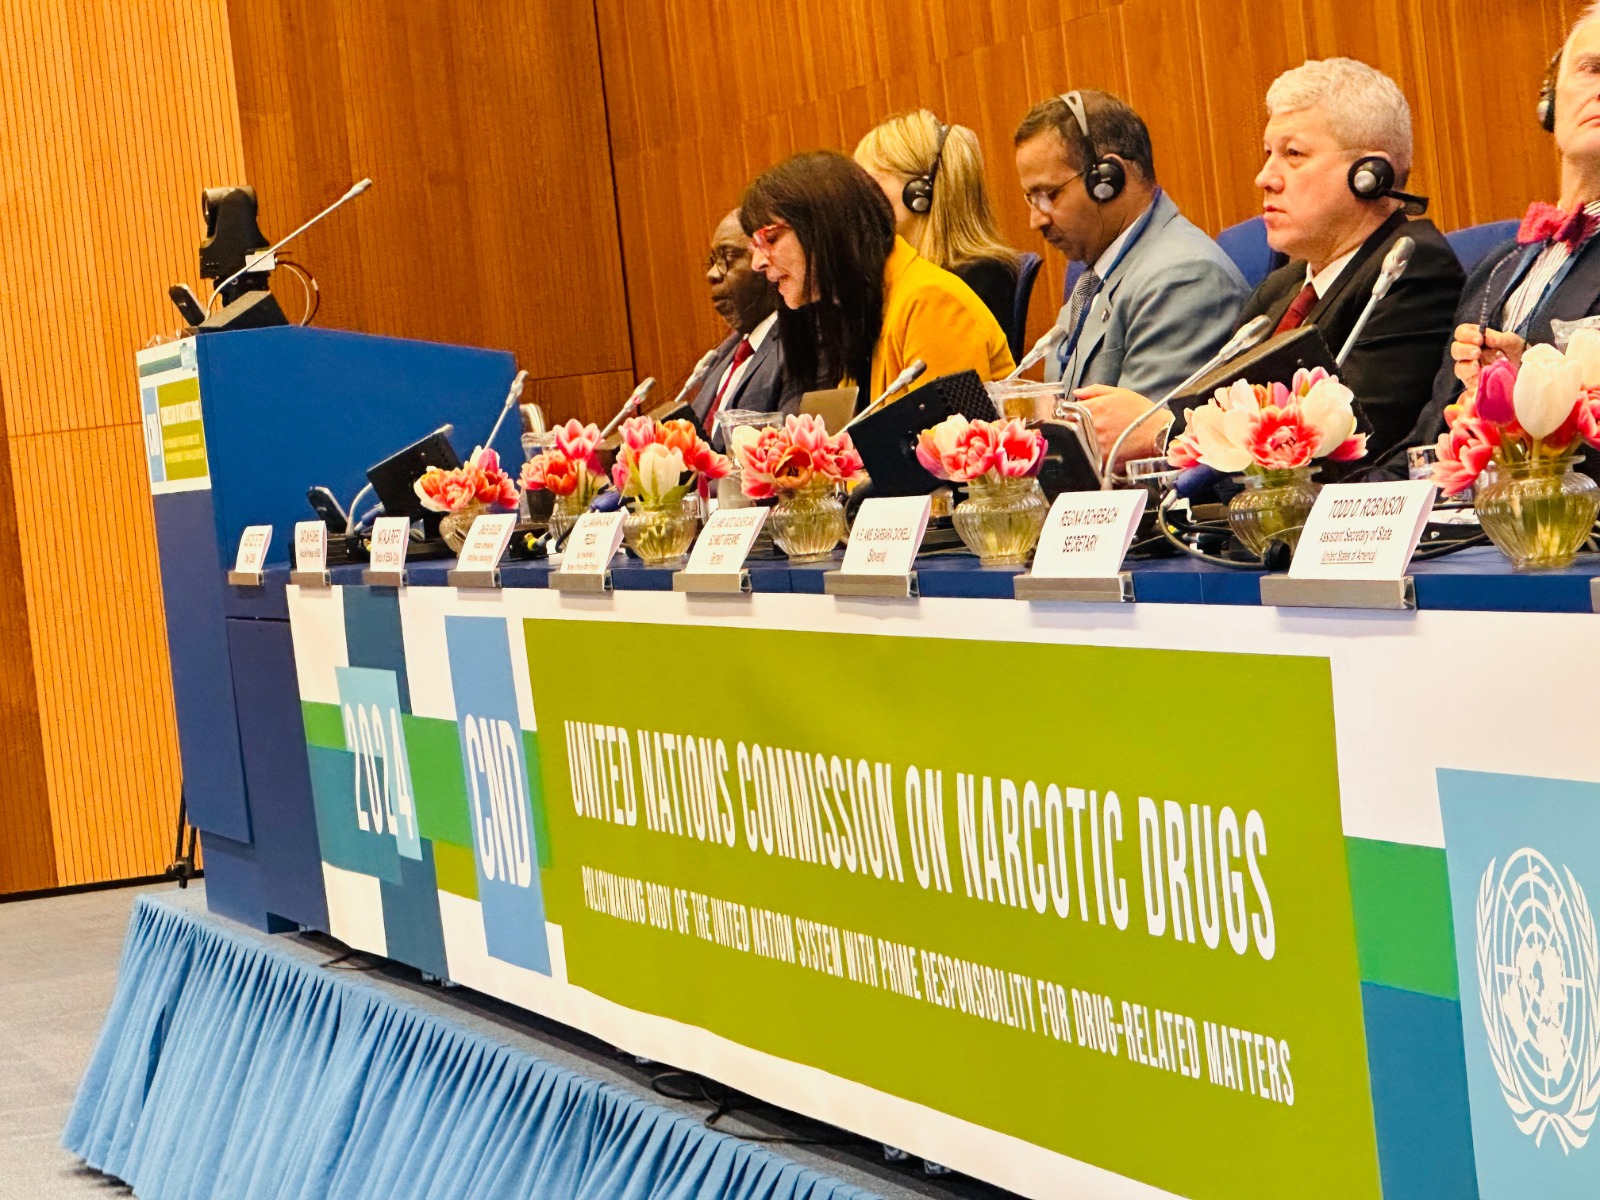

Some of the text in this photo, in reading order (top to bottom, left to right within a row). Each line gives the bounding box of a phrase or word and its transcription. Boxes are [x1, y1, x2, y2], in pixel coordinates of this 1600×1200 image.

[1060, 510, 1085, 527] REGINA
[1062, 534, 1099, 553] SECRETARY
[1328, 498, 1354, 518] TODD
[1360, 495, 1408, 517] ROBINSON
[1343, 527, 1370, 545] Secretary
[1376, 525, 1393, 541] State
[344, 702, 414, 841] 2024
[465, 713, 532, 888] CND
[564, 719, 1276, 961] UNITED NATIONS COMMISSION ON NARCOTIC DRUGS
[581, 865, 1295, 1107] POLICYMAKING BODY OF THE UNITED NATION SYSTEM WITH PRIME RESPONSIBILITY FOR DRUG-RELATED MATTERS
